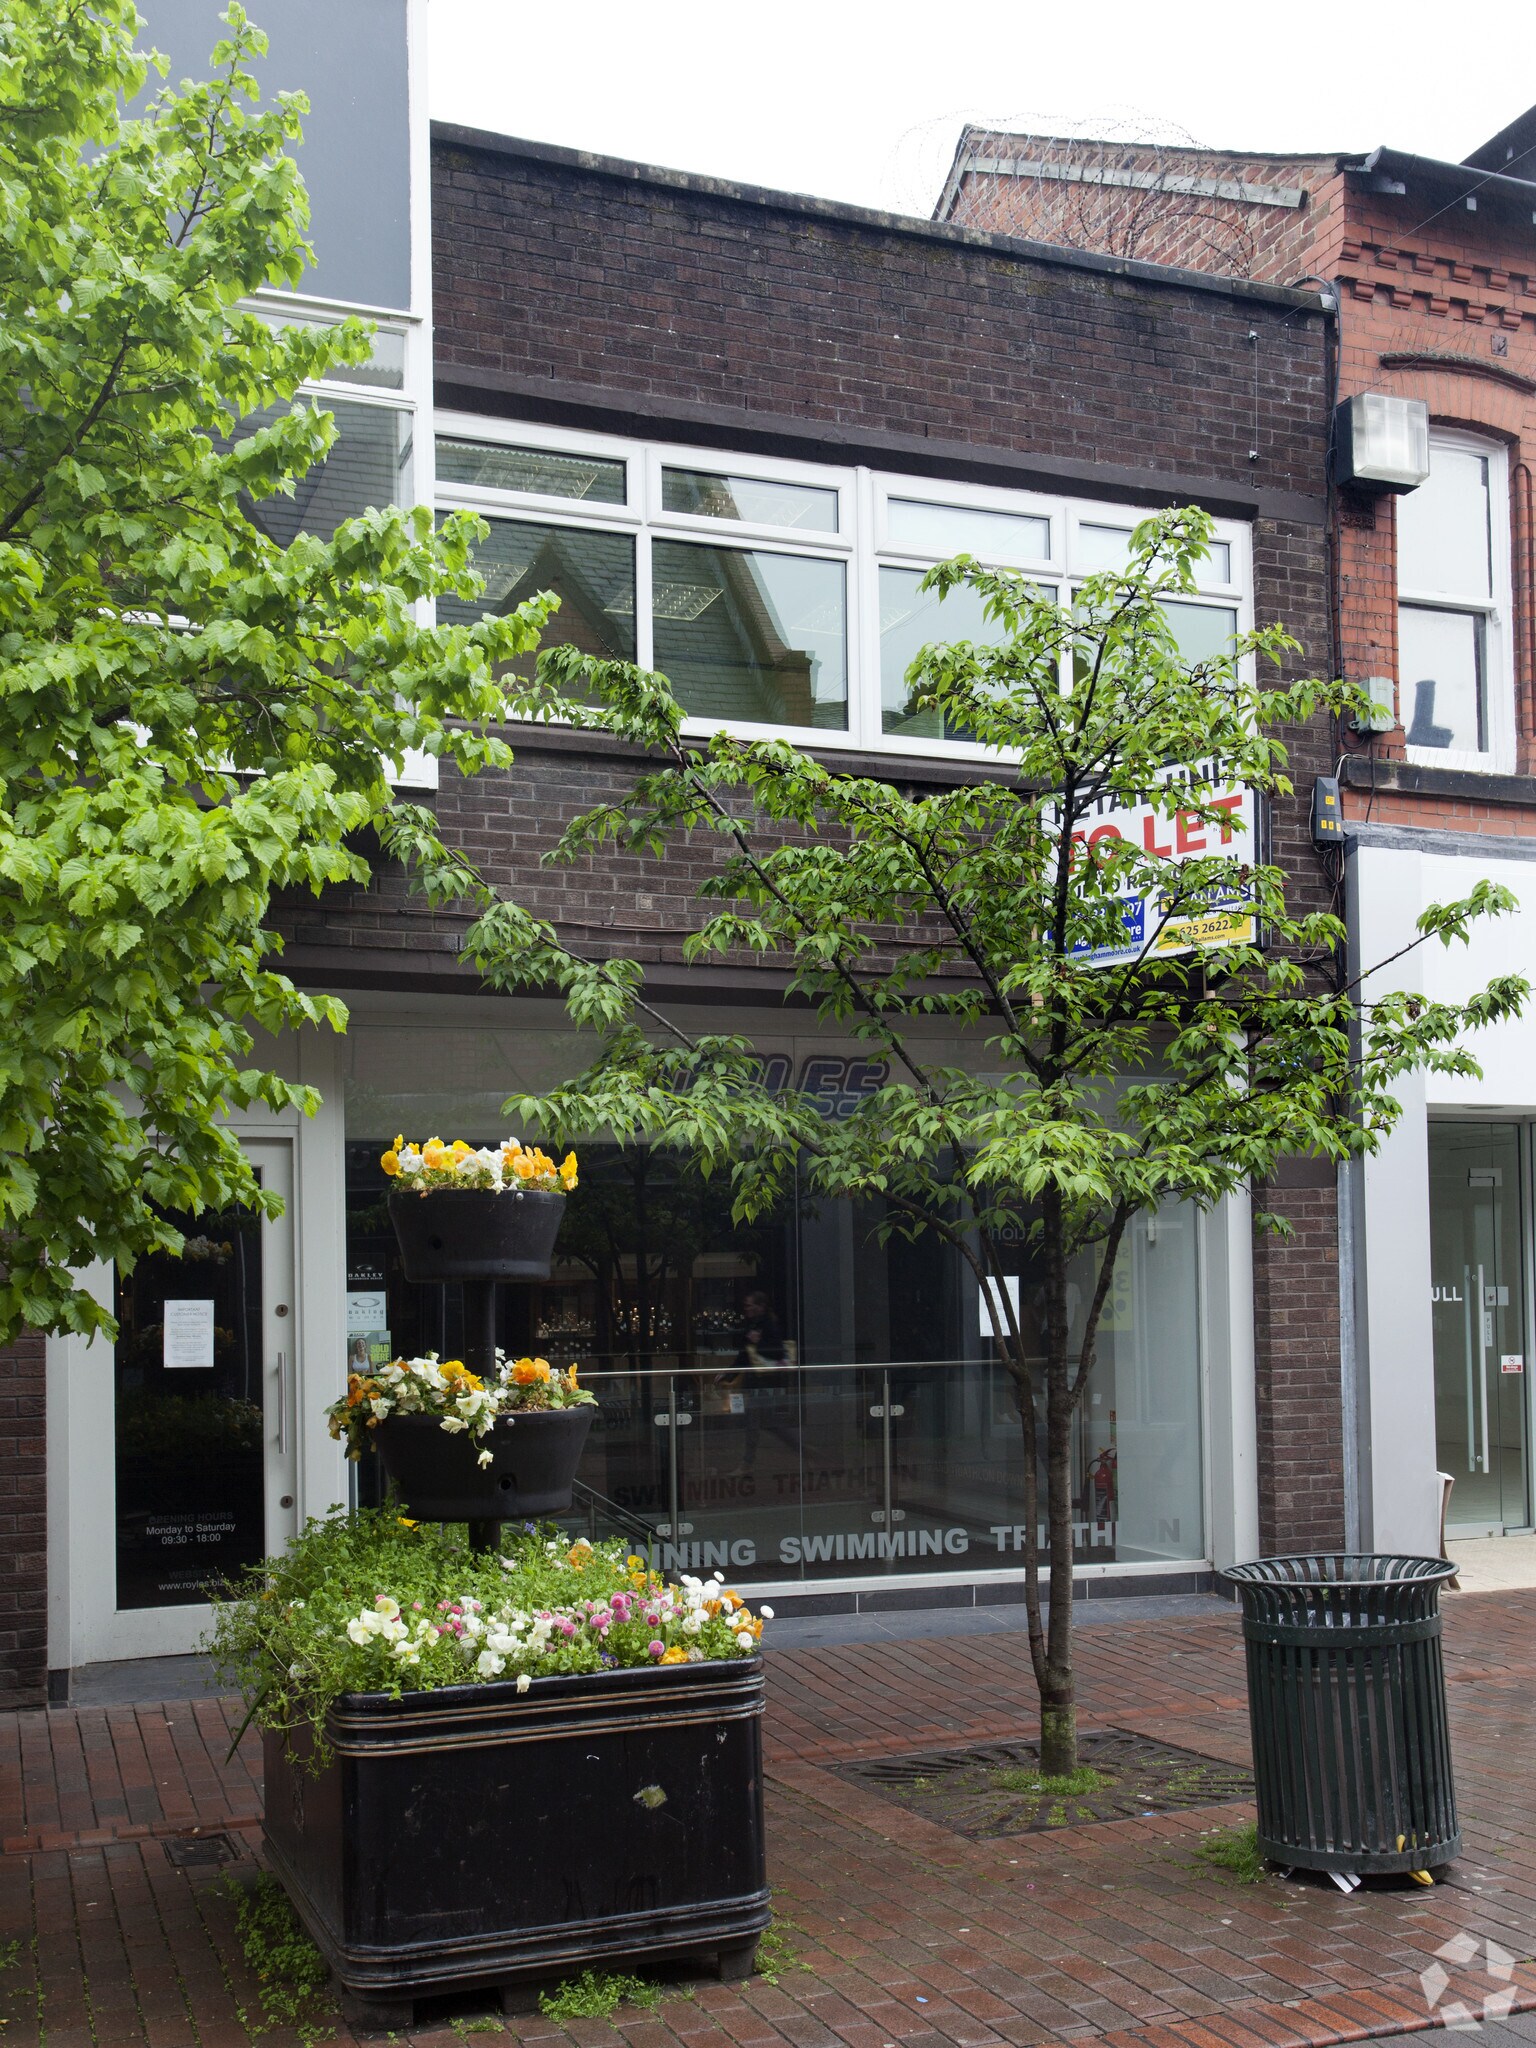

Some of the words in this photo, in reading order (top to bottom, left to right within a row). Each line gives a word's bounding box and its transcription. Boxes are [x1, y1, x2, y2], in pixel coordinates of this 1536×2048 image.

[1143, 795, 1243, 862] LET
[1431, 1286, 1463, 1302] ULL
[370, 1344, 389, 1353] SOLD
[146, 1526, 182, 1537] Monday
[184, 1525, 194, 1533] to
[196, 1522, 236, 1533] Saturday
[161, 1535, 188, 1545] 09:30
[196, 1533, 221, 1543] 18:00
[779, 1527, 969, 1565] SWIMMING
